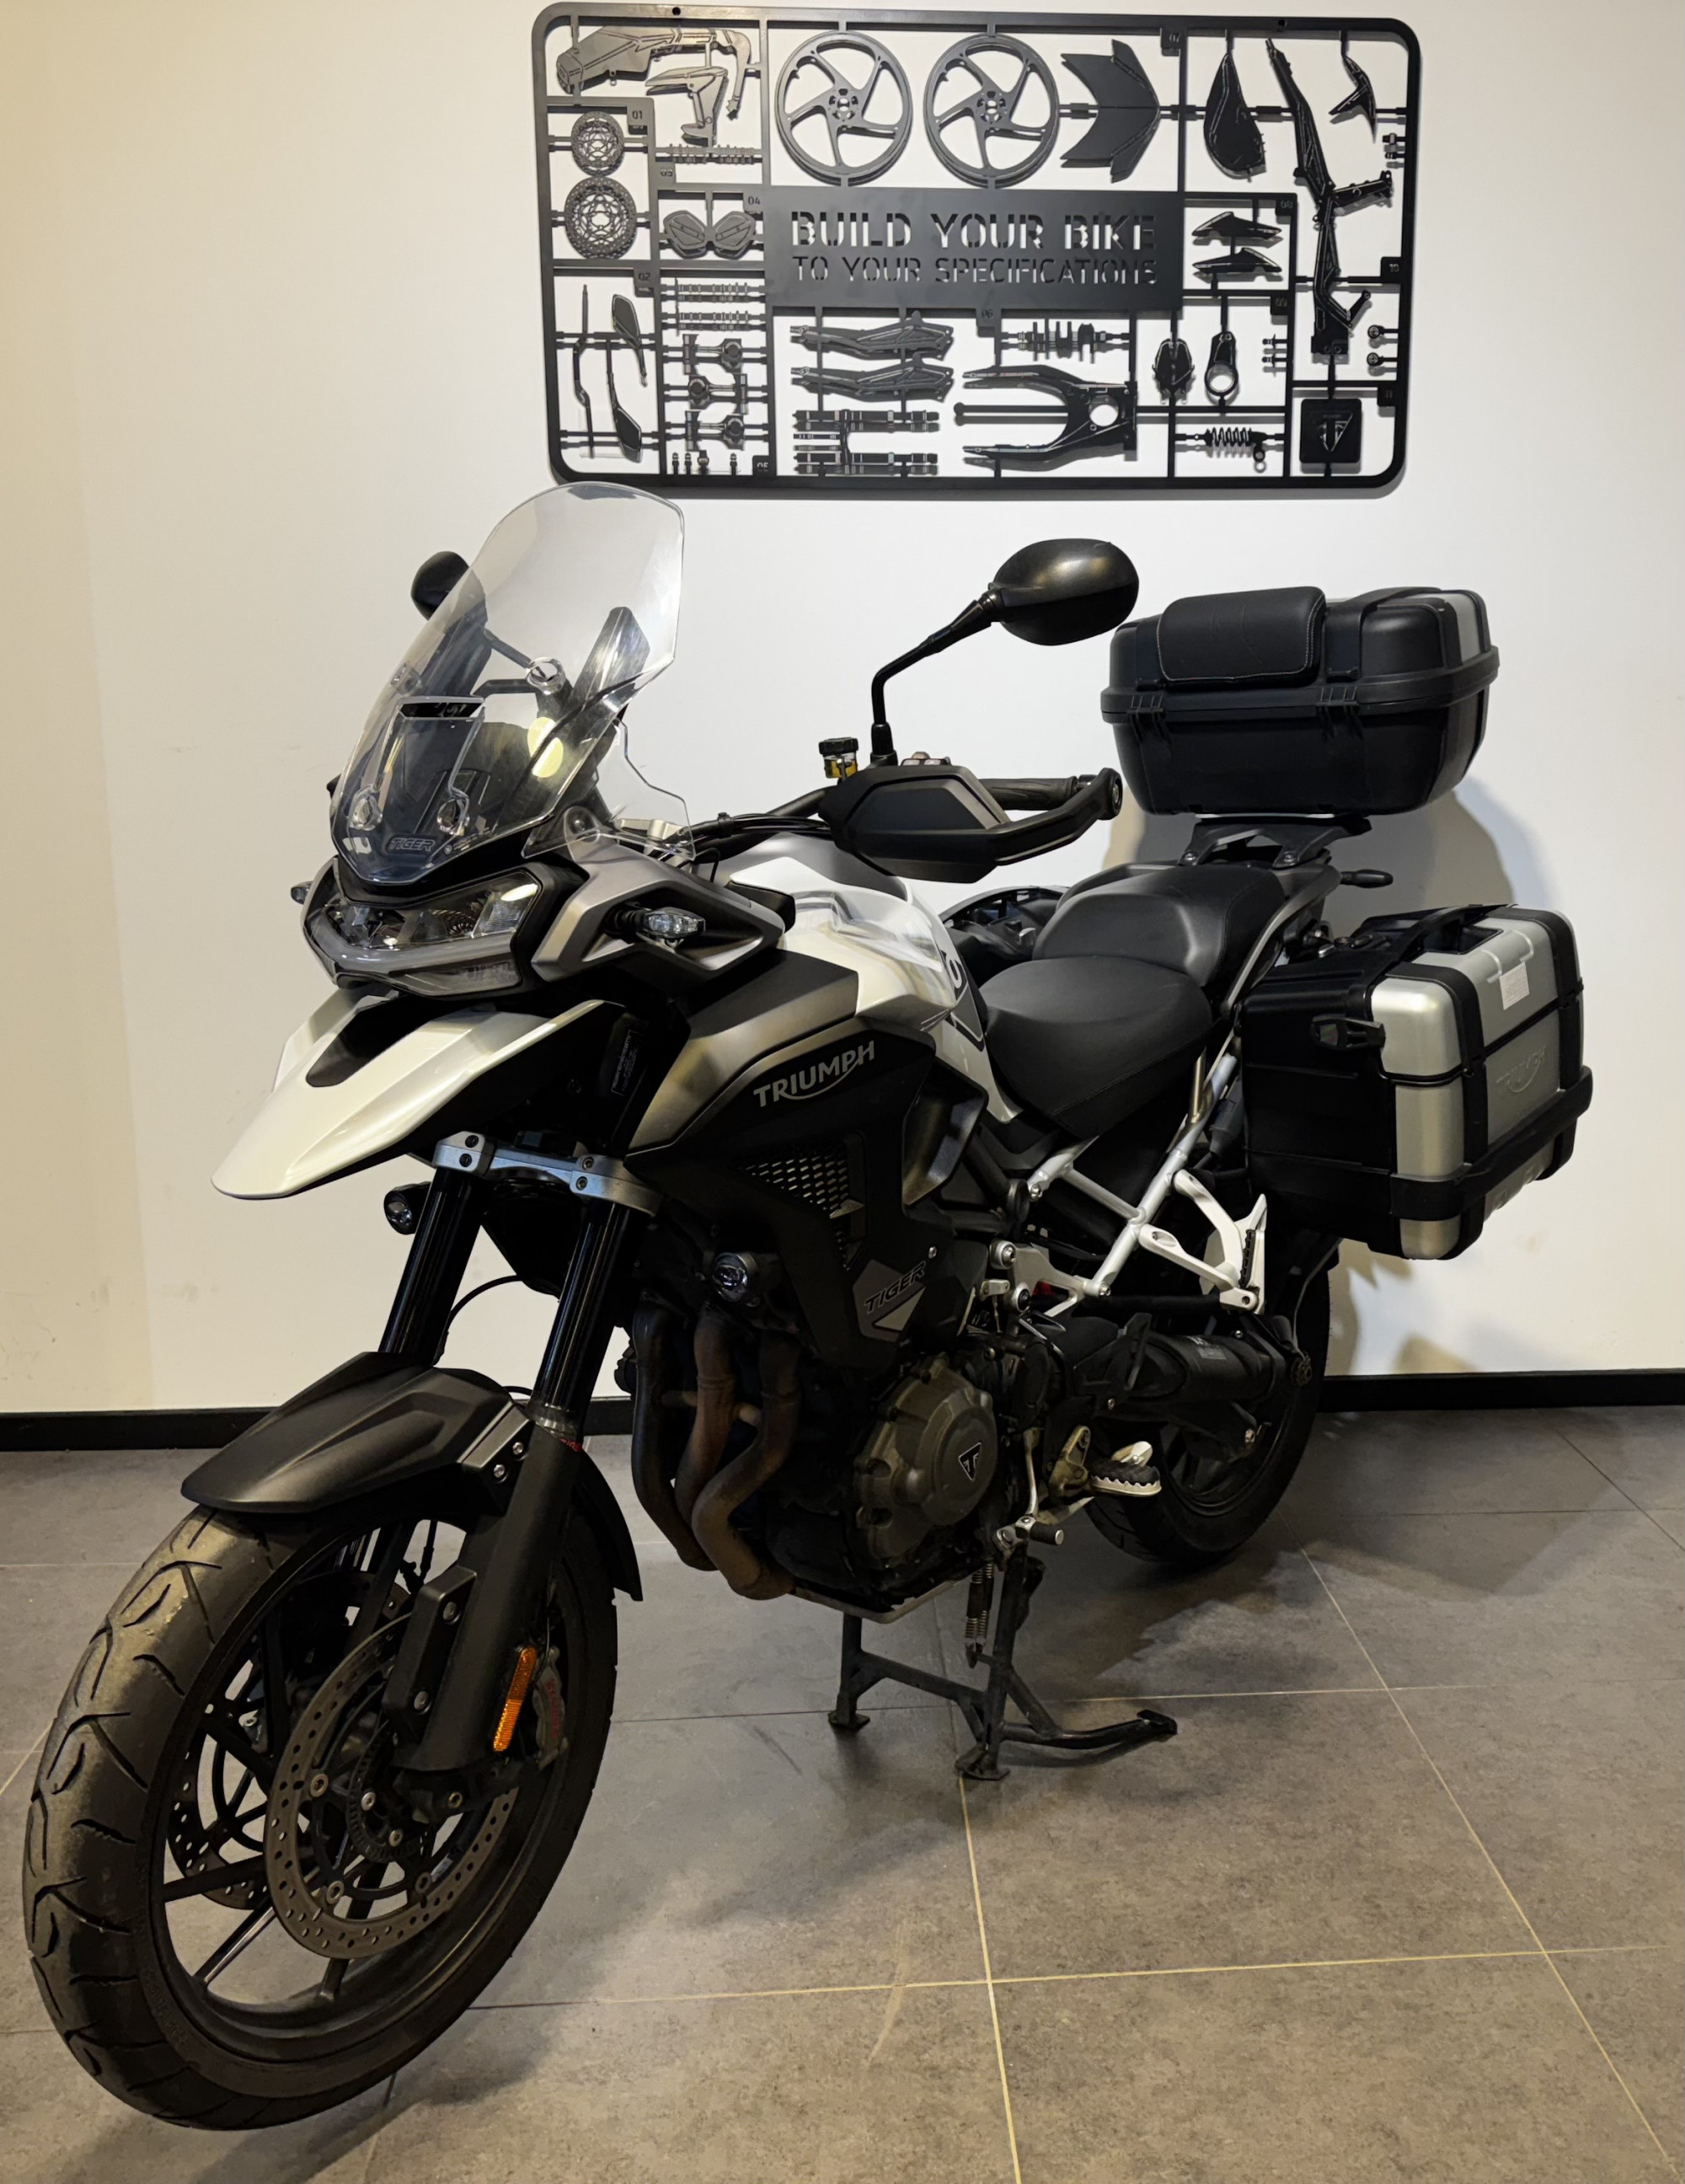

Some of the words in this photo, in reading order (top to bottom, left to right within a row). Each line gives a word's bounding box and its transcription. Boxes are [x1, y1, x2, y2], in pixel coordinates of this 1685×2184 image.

[632, 110, 643, 120] 01
[747, 195, 761, 206] 04
[791, 211, 912, 249] BUILD
[931, 212, 1044, 250] YOUR
[1063, 214, 1157, 251] BIKE
[792, 255, 829, 281] TO
[842, 256, 921, 282] YOUR
[934, 257, 1157, 286] SPECIFICATIONS
[389, 837, 436, 852] TIGER
[753, 1040, 875, 1108] TRIUMPH
[864, 1261, 927, 1314] TIGER
